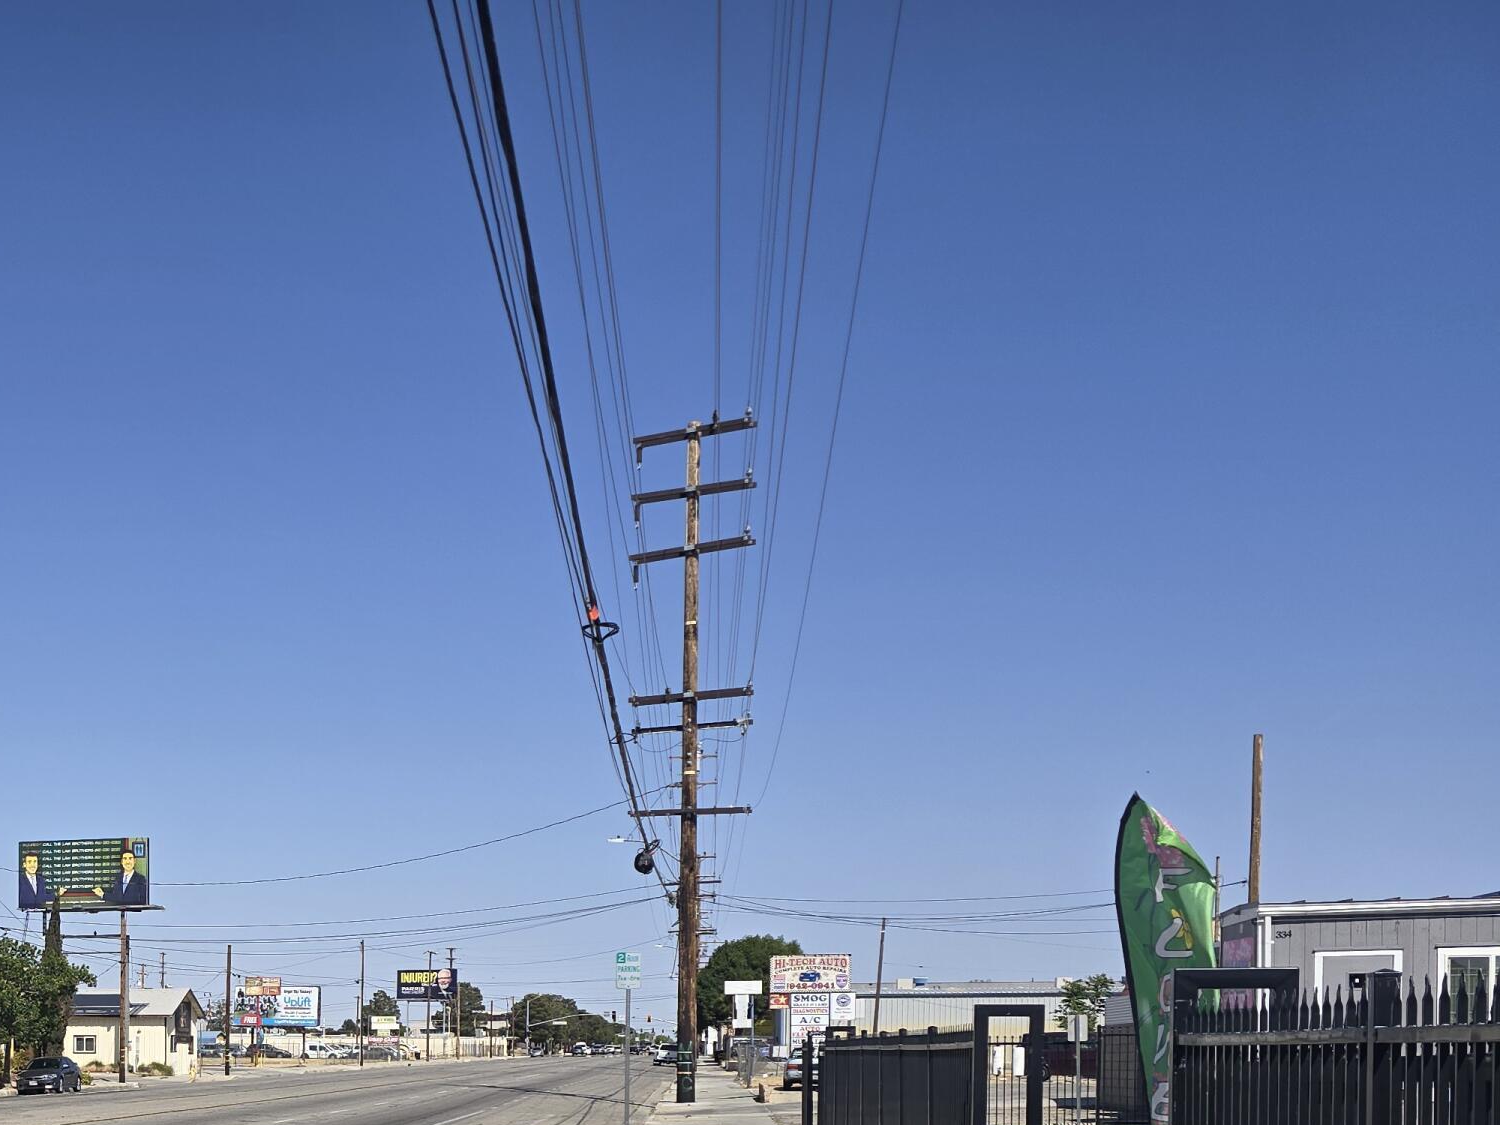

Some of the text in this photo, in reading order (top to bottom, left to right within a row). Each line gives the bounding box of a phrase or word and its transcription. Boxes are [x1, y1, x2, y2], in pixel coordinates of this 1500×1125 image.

[1276, 930, 1292, 938] 334
[618, 954, 625, 962] 2
[775, 958, 848, 969] HI-TECH AUTO
[794, 994, 827, 1002] SMOG
[800, 1016, 821, 1024] A/C
